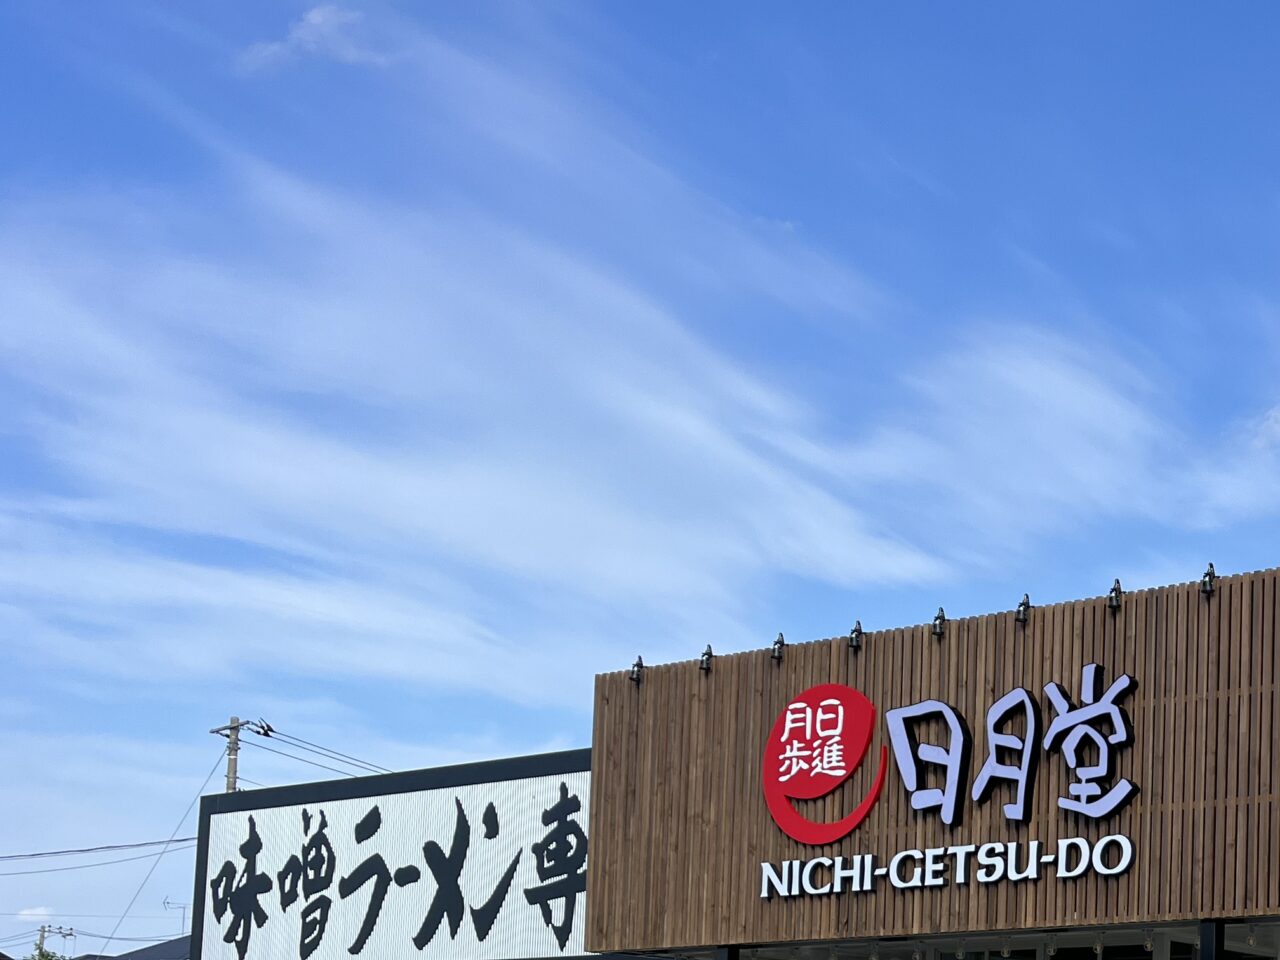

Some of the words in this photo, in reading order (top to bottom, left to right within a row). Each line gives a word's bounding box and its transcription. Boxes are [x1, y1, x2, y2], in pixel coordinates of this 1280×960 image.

[886, 663, 1139, 825] 日月堂
[760, 834, 1137, 898] NICHI-GETSU-DO
